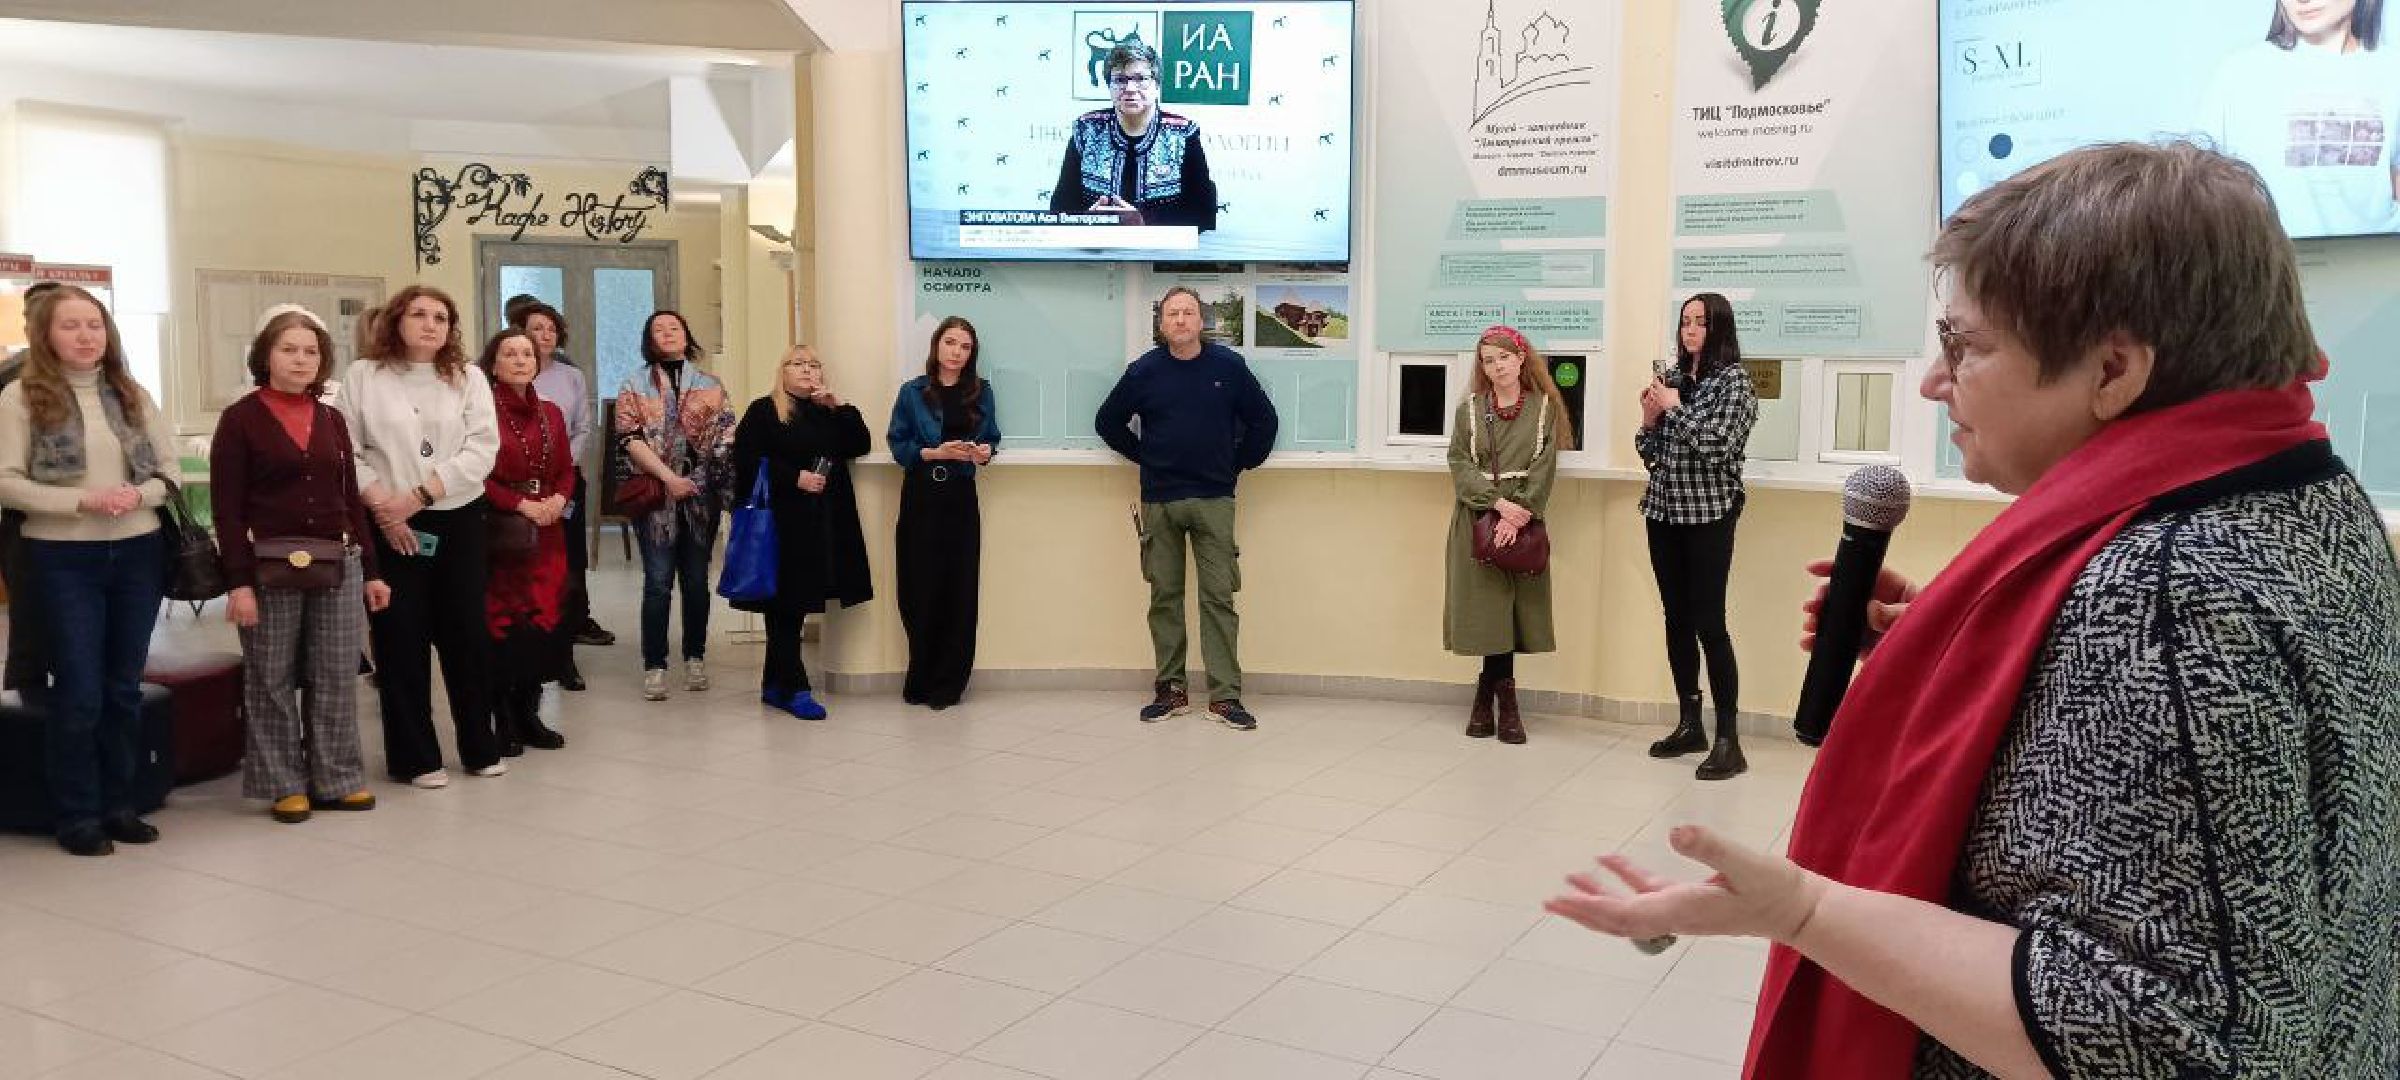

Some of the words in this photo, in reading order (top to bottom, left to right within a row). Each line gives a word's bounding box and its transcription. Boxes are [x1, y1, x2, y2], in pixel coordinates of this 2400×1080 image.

[1183, 23, 1234, 52] ИА
[1174, 60, 1240, 91] РАН
[1692, 105, 1722, 121] ТИЦ
[1703, 156, 1799, 169] visitdmitrov.ru
[1497, 165, 1587, 177] dmmuseum.ru
[923, 266, 982, 278] НАЧАЛО
[923, 282, 992, 293] ОСМОТРА
